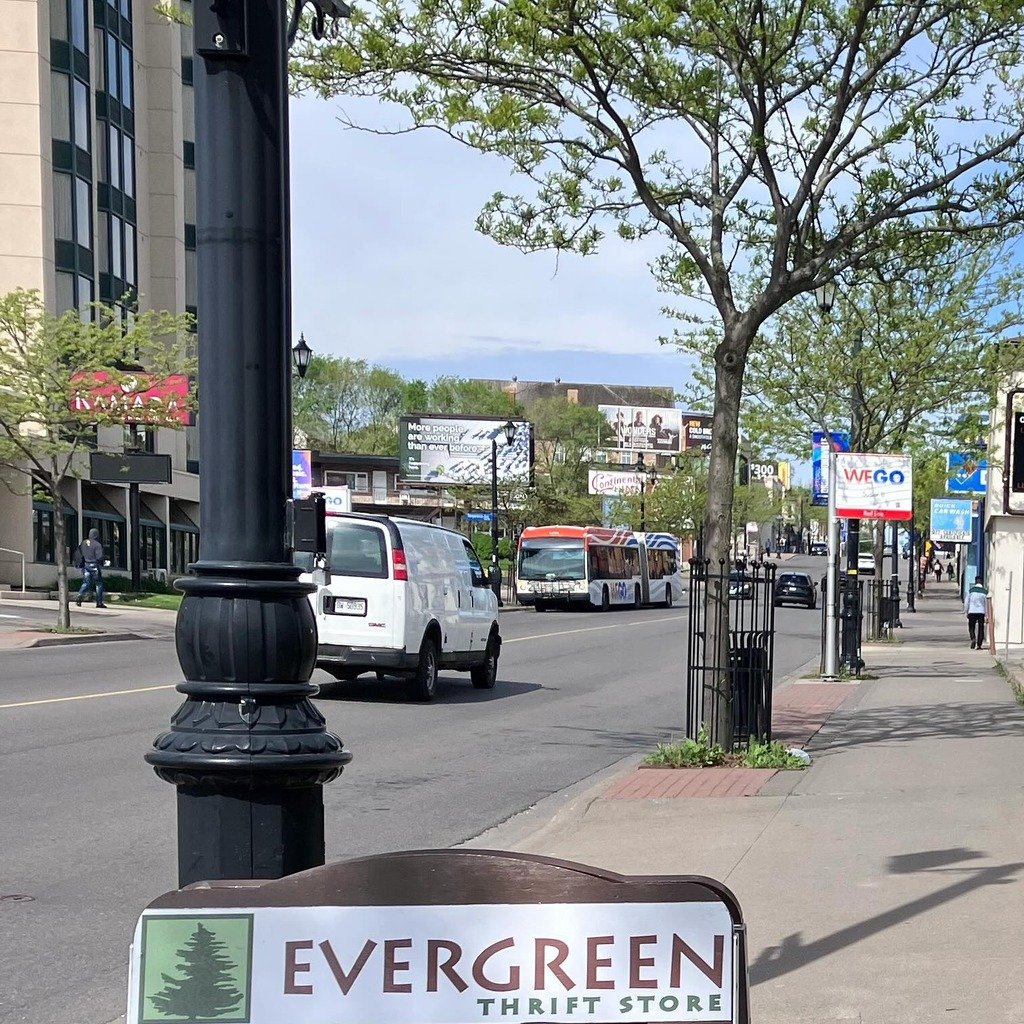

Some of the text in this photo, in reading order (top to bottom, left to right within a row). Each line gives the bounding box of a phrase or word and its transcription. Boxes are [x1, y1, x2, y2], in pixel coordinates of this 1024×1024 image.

[407, 422, 464, 434] More people
[425, 433, 460, 443] working
[407, 441, 428, 450] than
[428, 443, 448, 451] ever
[844, 468, 905, 485] WEGO
[283, 933, 725, 996] EVERGREEN
[476, 994, 723, 1016] THRIFT STORE
